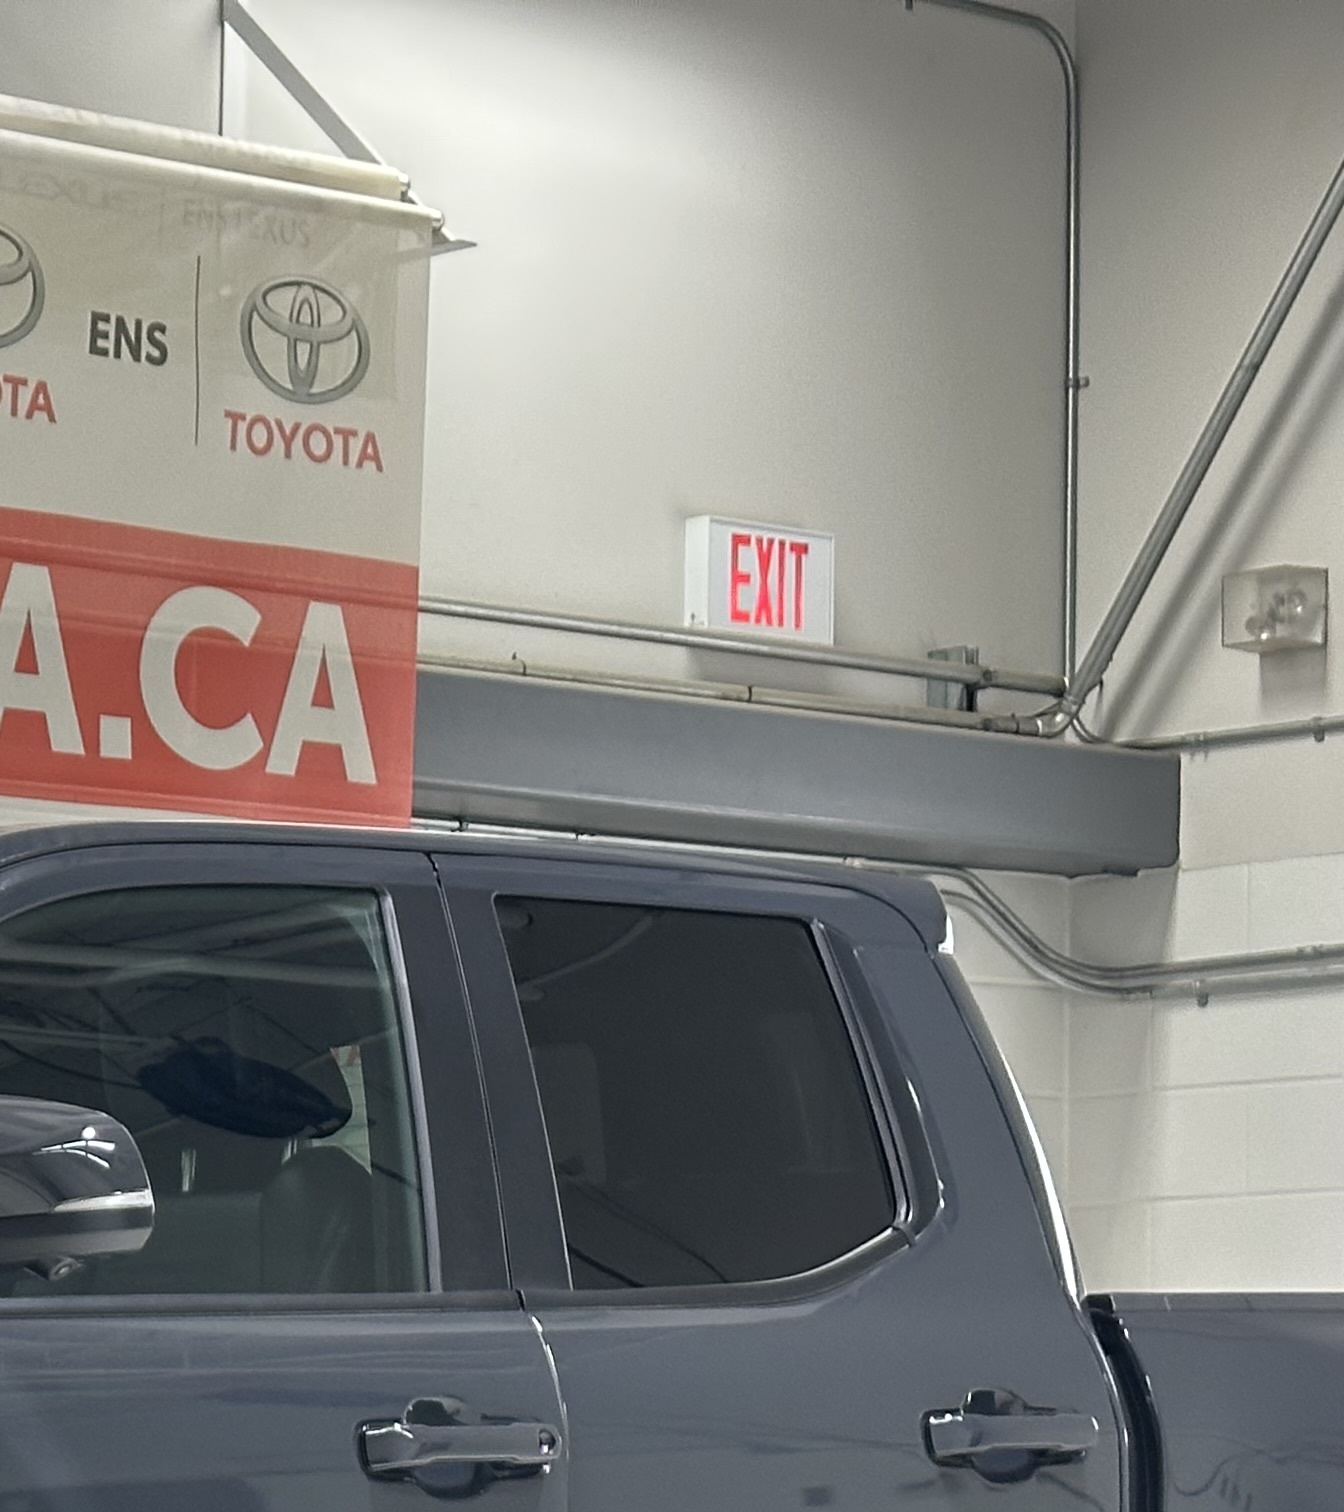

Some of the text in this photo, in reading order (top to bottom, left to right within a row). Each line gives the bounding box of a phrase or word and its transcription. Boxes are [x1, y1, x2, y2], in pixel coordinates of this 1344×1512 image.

[87, 310, 169, 367] ENS
[223, 409, 384, 474] TOYOTA
[728, 532, 809, 631] EXIT
